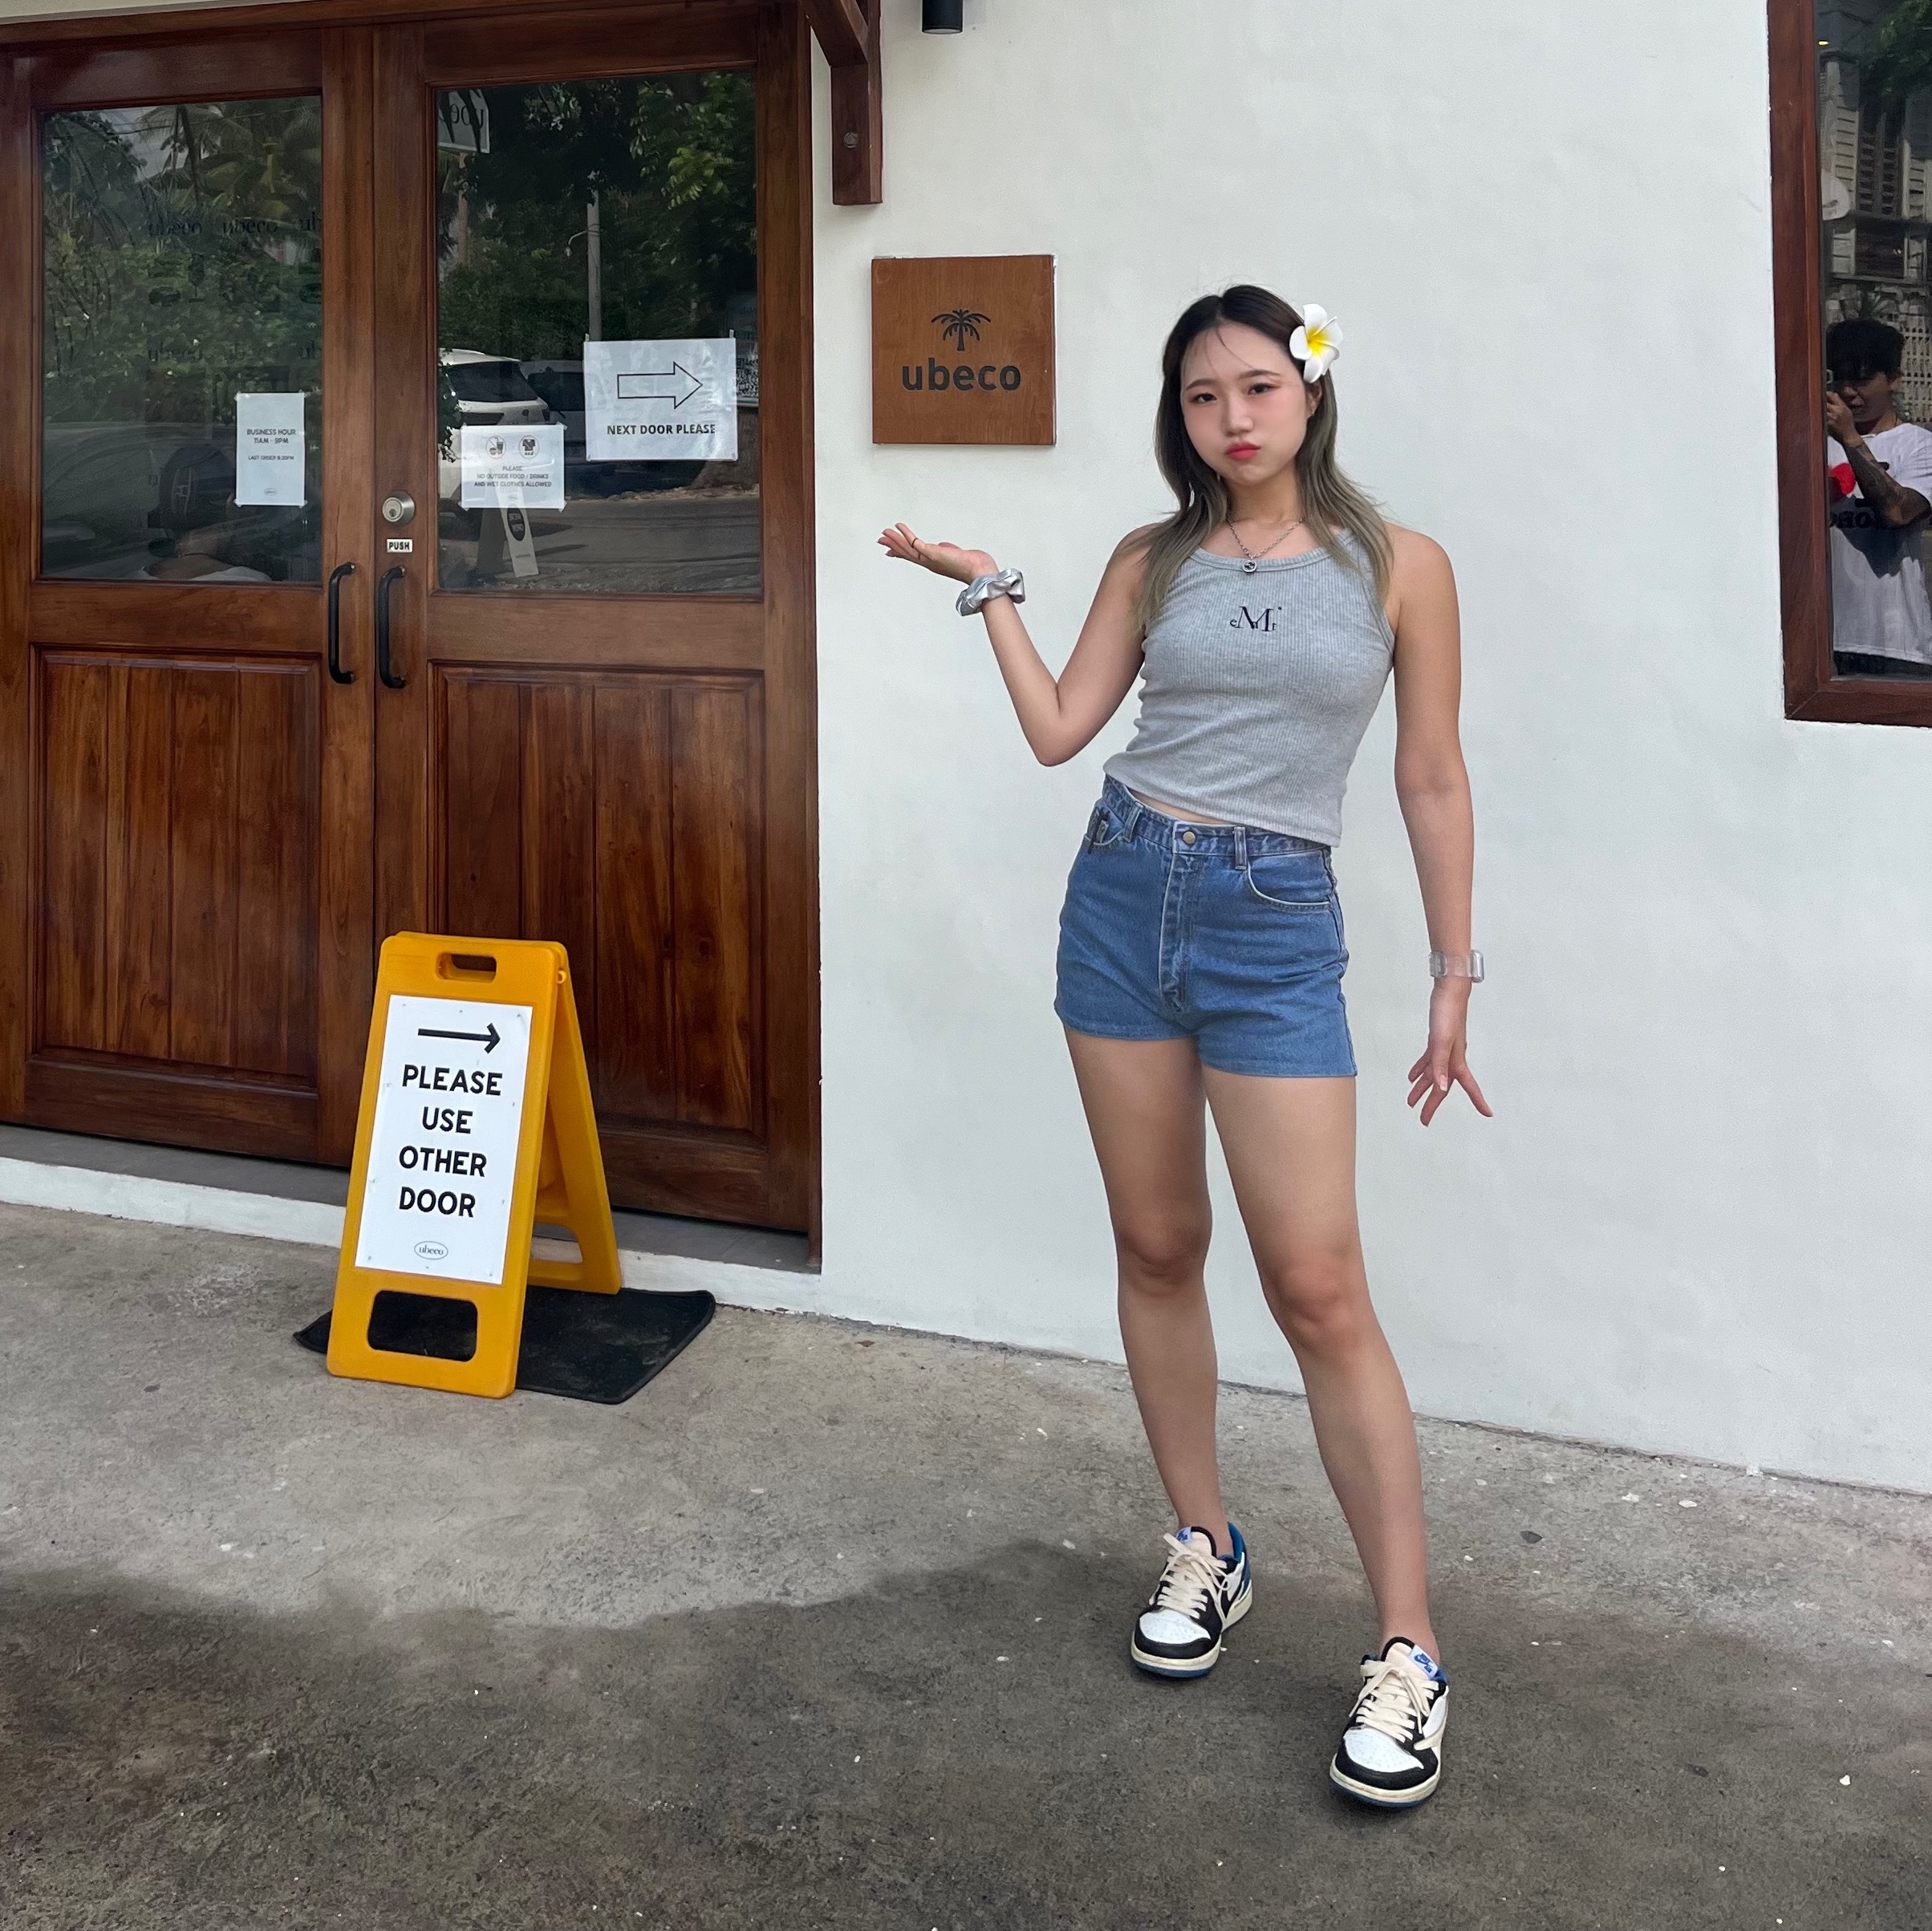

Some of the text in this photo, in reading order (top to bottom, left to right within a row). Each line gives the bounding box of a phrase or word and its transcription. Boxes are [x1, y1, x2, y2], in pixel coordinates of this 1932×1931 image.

[902, 357, 1021, 391] ubeco
[607, 424, 716, 435] NEXT DOOR PLEASE
[388, 542, 410, 550] PUSH
[401, 1064, 503, 1097] PLEASE
[421, 1106, 474, 1134] USE
[398, 1145, 488, 1178] OTHER
[399, 1186, 476, 1219] DOOR
